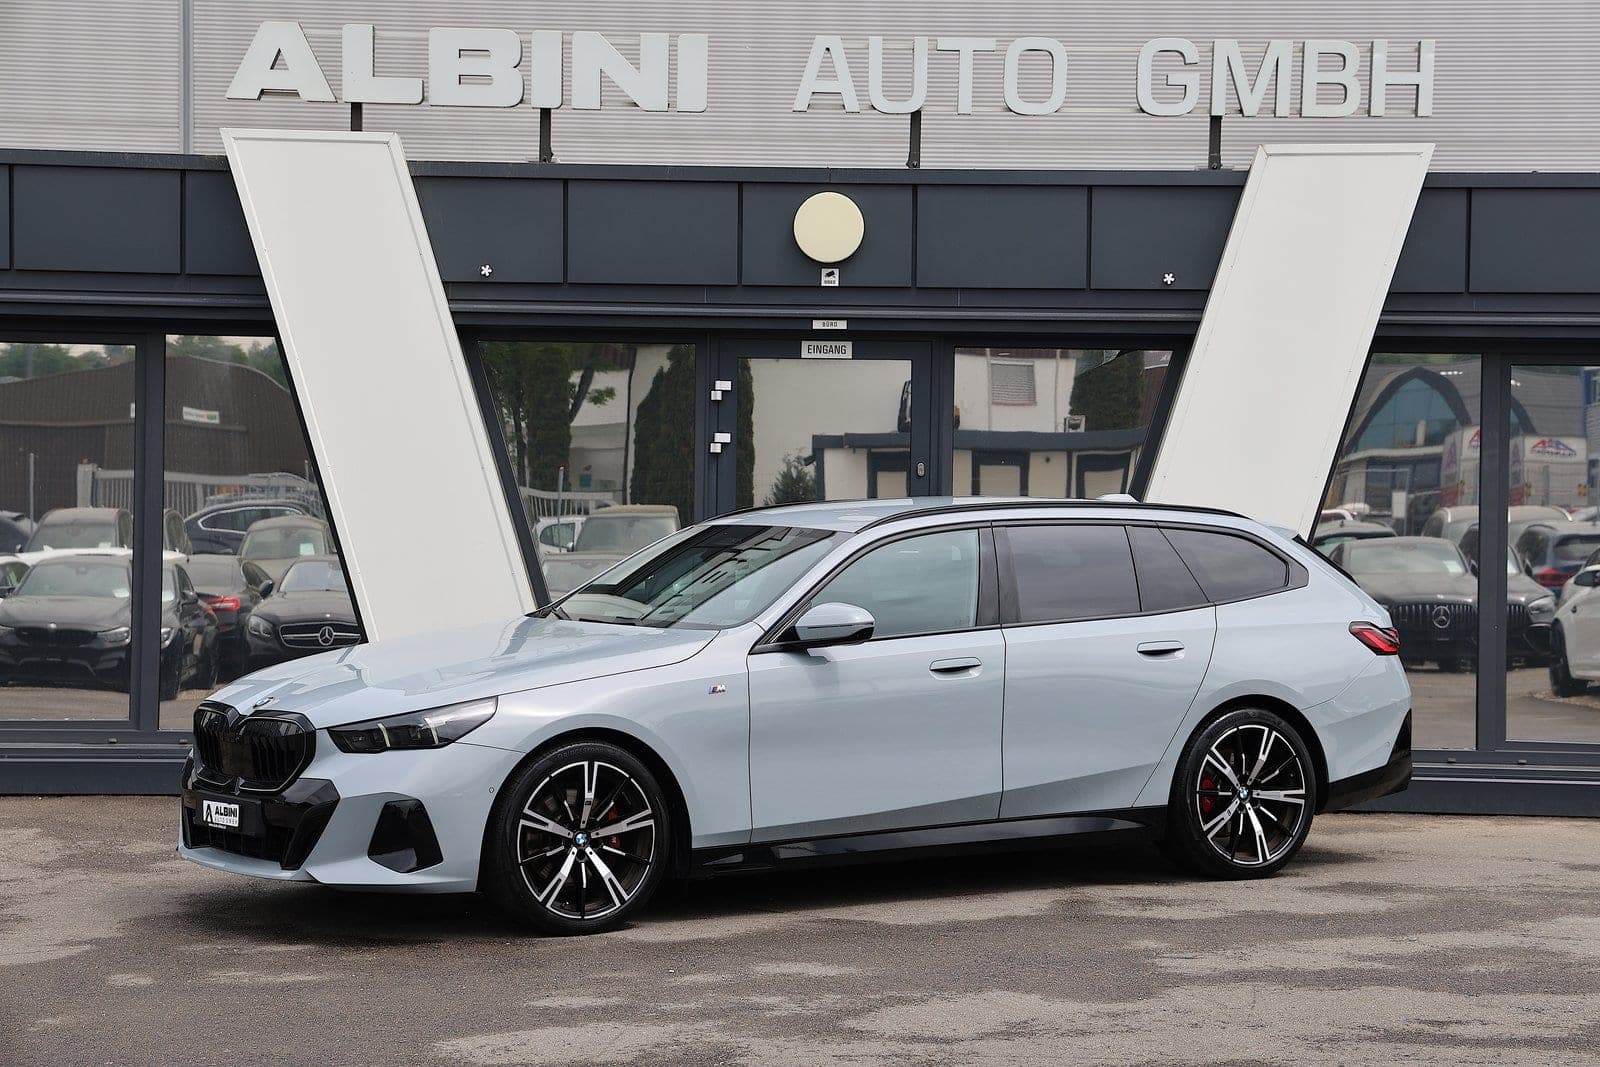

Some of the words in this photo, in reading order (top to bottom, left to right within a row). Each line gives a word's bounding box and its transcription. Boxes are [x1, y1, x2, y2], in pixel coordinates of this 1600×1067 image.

[225, 21, 709, 113] ALBINI
[792, 35, 1068, 115] AUTO
[1136, 37, 1436, 118] GMBH
[807, 344, 847, 355] EINGANG
[214, 806, 238, 818] ALBINI
